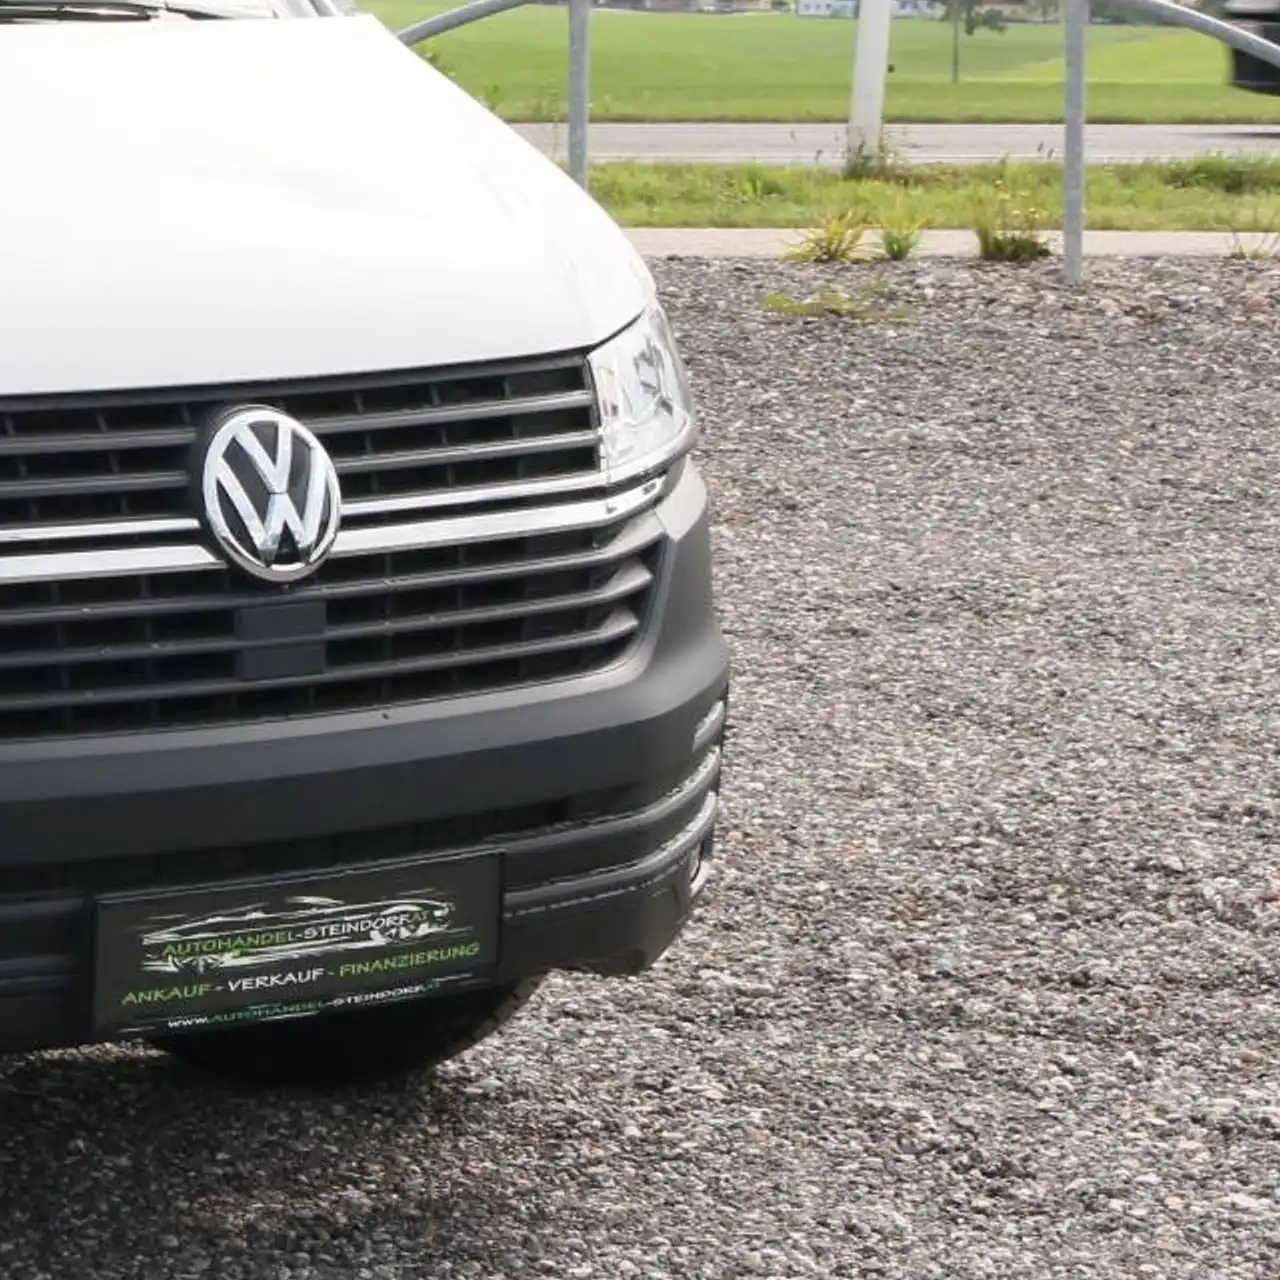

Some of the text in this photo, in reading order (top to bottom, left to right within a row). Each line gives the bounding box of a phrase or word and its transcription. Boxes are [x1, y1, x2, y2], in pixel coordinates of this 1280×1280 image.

[205, 407, 340, 580] VW
[121, 984, 212, 1006] ANKAUF
[228, 968, 324, 992] VERKAUF
[340, 942, 481, 977] FINANZIERUNG
